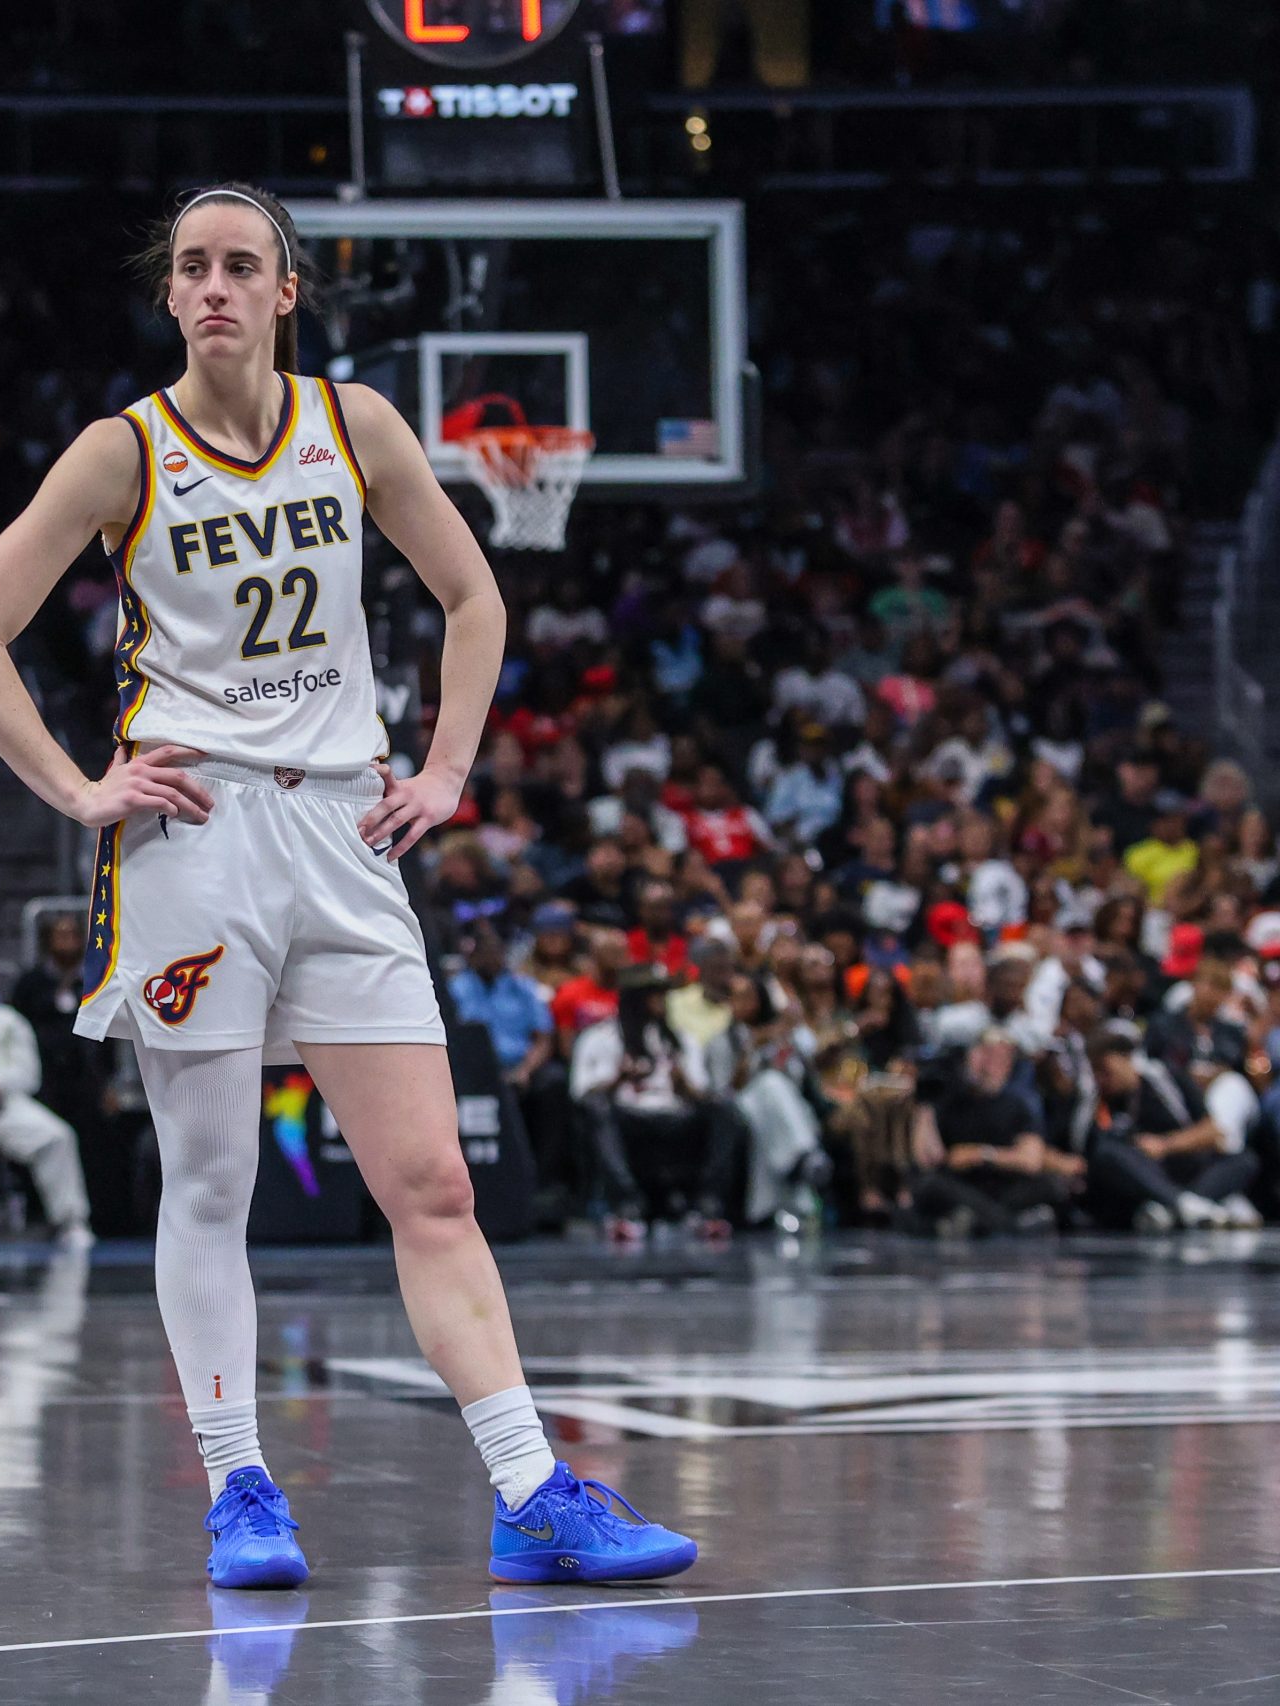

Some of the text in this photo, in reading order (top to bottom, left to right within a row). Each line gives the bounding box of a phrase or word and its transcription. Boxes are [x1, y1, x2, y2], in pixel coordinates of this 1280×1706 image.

[431, 83, 578, 118] TISSOT
[299, 444, 336, 466] Lilly
[169, 496, 351, 576] FEVER
[234, 567, 328, 661] 22
